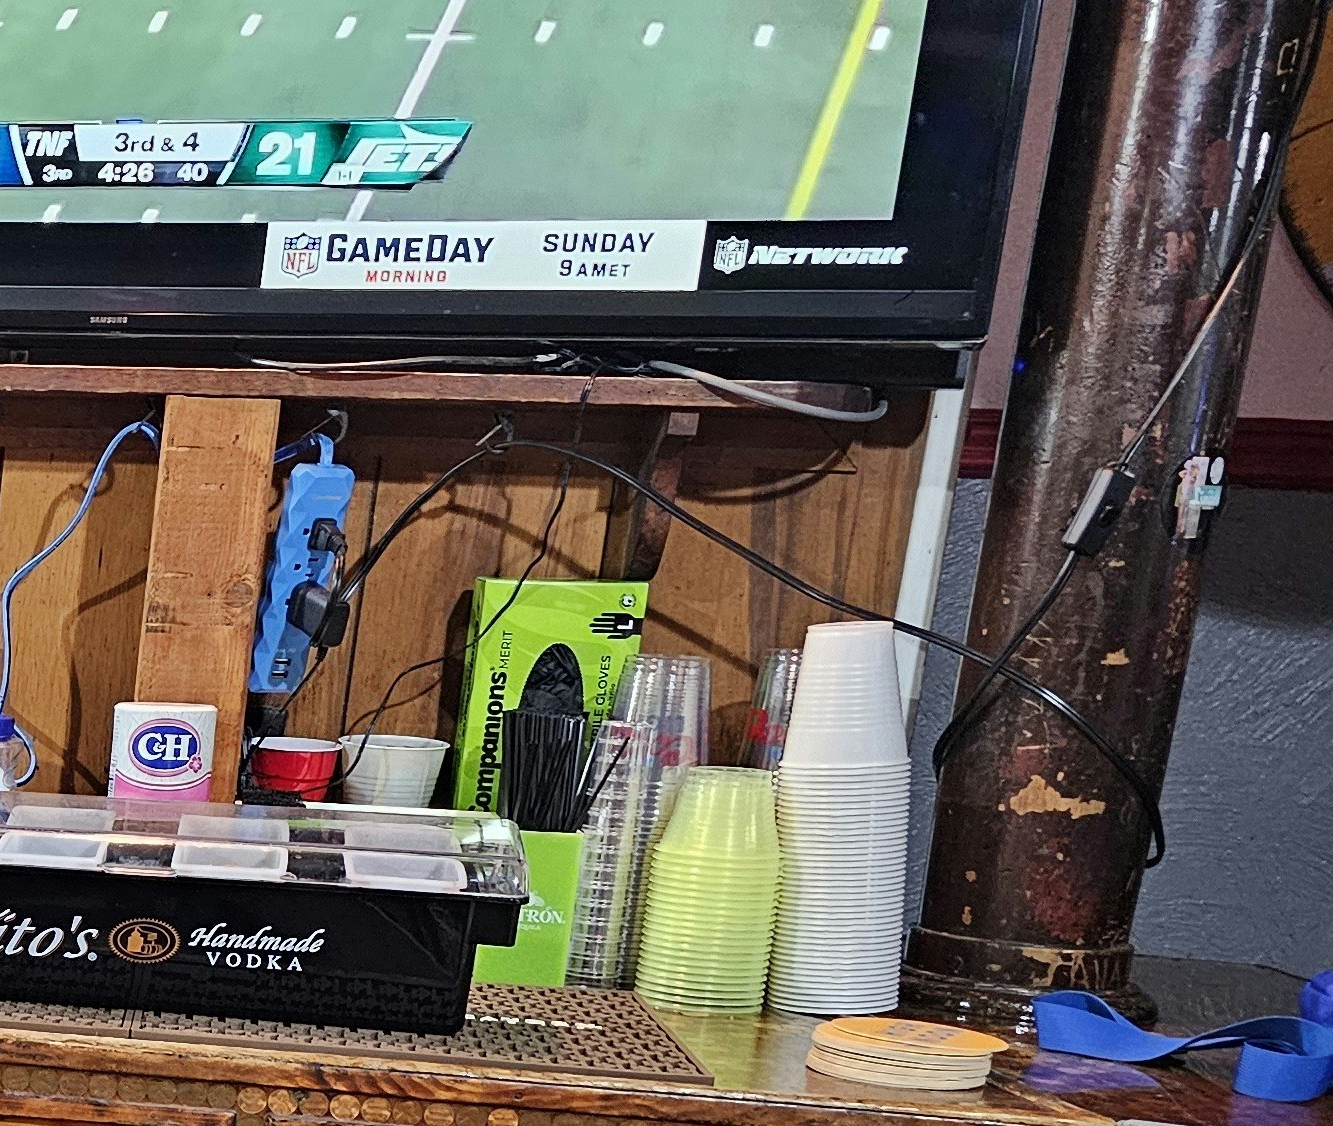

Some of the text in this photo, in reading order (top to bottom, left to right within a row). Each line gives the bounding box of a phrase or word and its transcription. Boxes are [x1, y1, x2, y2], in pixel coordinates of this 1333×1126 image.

[25, 130, 73, 158] TNF
[114, 130, 200, 153] 3rd & 4
[255, 131, 316, 176] 21
[97, 161, 209, 183] 4:26 40
[542, 231, 655, 254] SUNDAY
[285, 252, 315, 272] NFL
[365, 269, 448, 284] MORNING
[500, 629, 515, 670] MERIT
[597, 654, 612, 706] GLOVES
[137, 732, 193, 761] C&H
[518, 907, 563, 925] TRÓN
[188, 922, 326, 954] Handmade
[205, 950, 304, 972] VODKA
